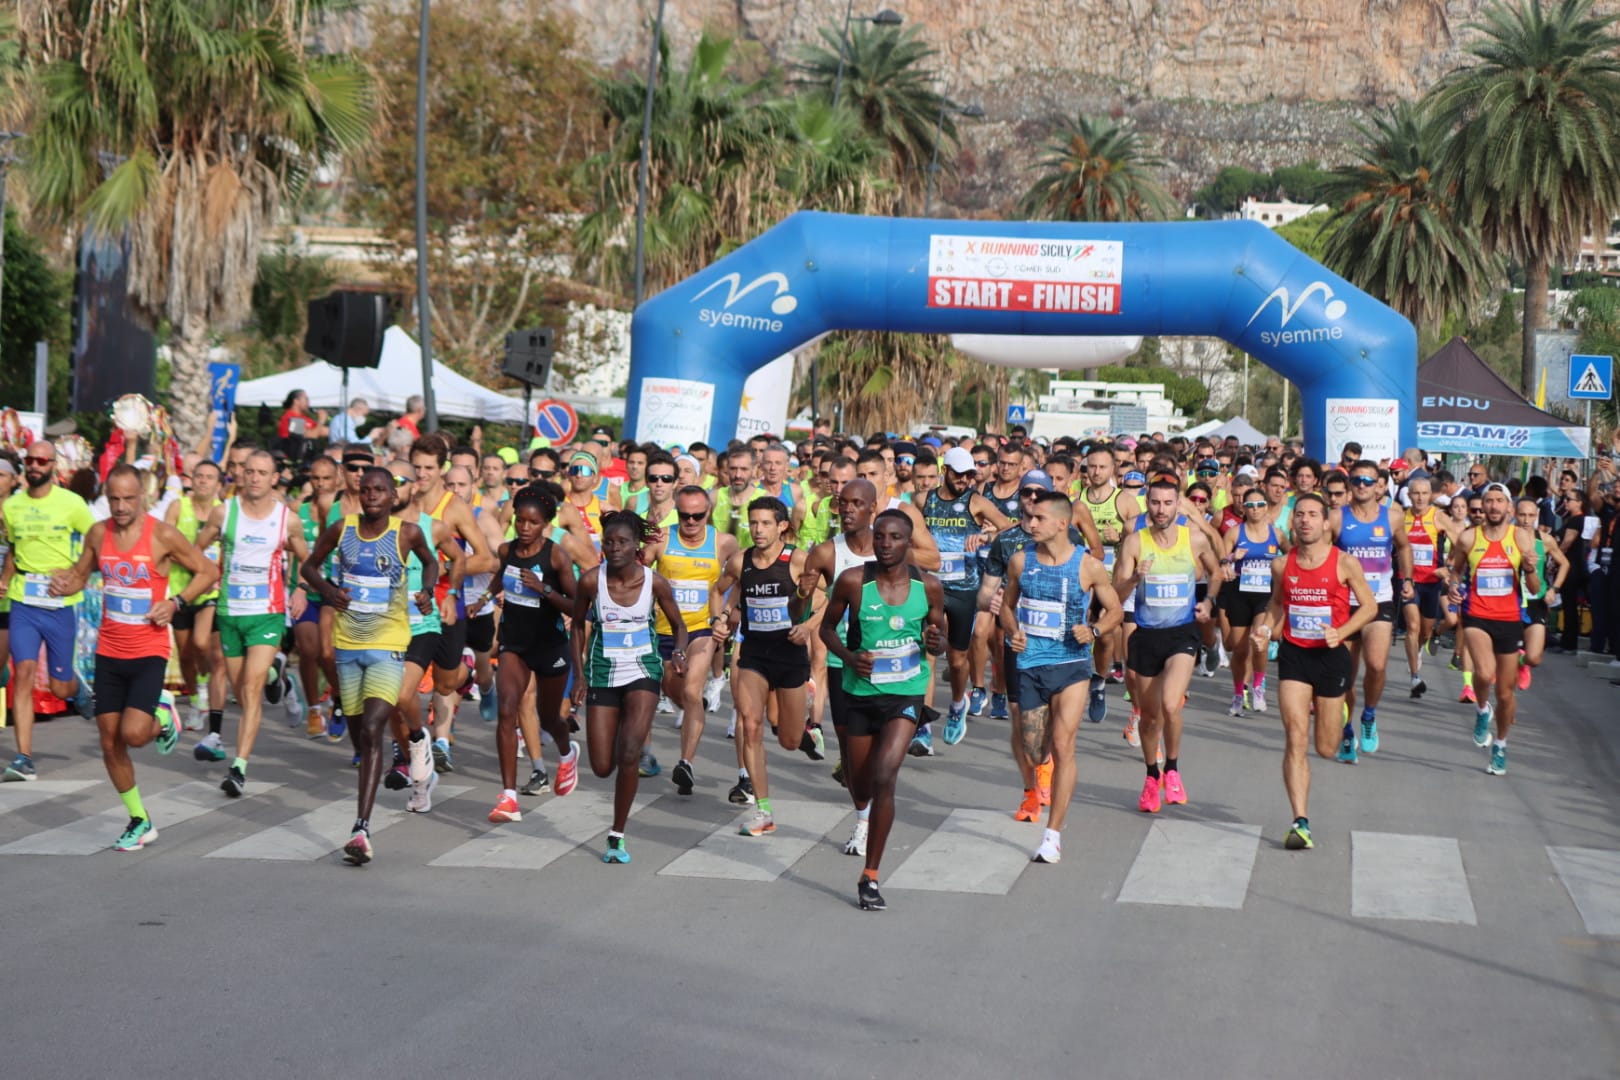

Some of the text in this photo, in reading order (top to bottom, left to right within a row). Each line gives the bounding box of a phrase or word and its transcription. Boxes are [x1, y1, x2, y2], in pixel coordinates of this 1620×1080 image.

[935, 279, 1013, 308] START
[1033, 283, 1115, 311] FINISH
[699, 308, 783, 332] syemme
[1260, 326, 1343, 347] syemme
[1422, 396, 1490, 410] ENDU
[739, 416, 771, 433] CITO
[1416, 423, 1506, 440] SDAM
[103, 562, 151, 585] AQA
[239, 586, 257, 599] 23
[359, 588, 370, 602] 2
[675, 589, 699, 604] 519
[755, 583, 781, 596] MET
[1155, 584, 1179, 599] 119
[1290, 587, 1327, 595] vicenza
[121, 598, 133, 612] 6
[1290, 594, 1328, 602] runners
[753, 607, 783, 622] 399
[1027, 610, 1050, 627] 112
[622, 633, 634, 648] 4
[890, 658, 903, 673] 3
